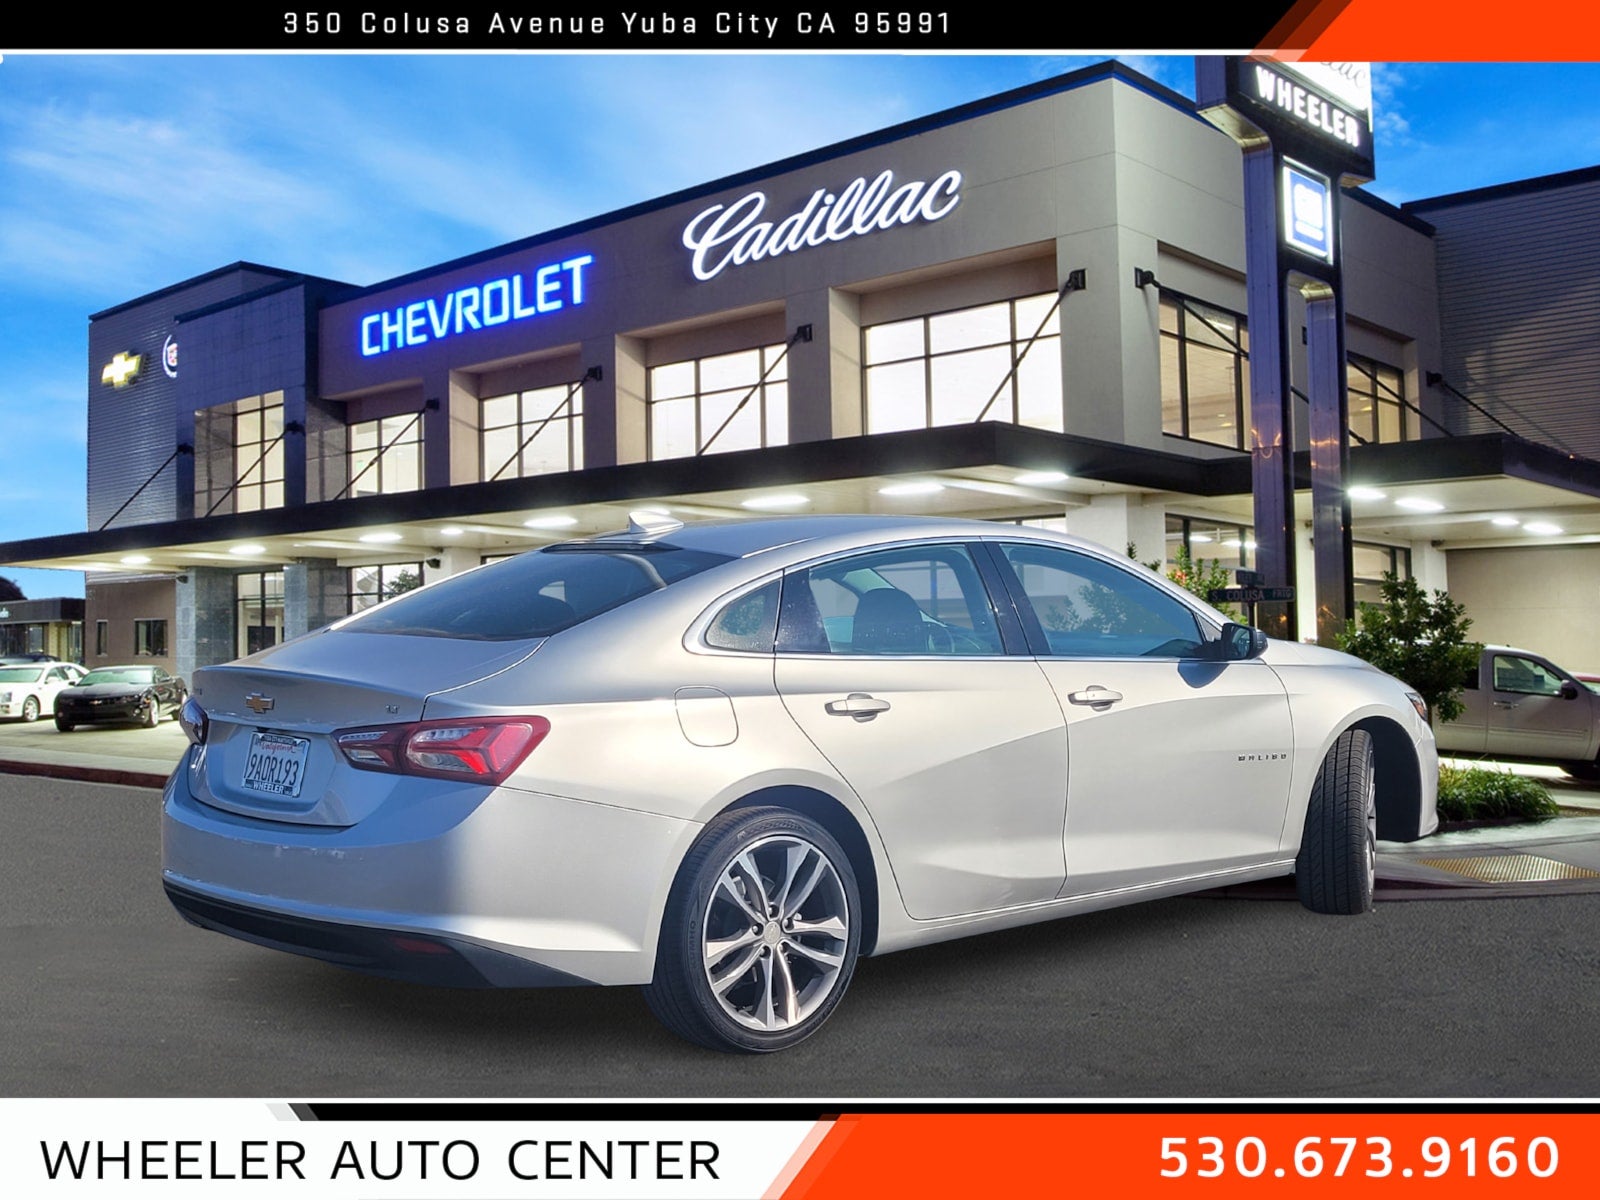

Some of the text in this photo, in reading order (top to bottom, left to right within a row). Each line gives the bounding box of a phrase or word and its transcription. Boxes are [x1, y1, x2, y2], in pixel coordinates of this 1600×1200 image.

[1255, 65, 1360, 148] WHEELER
[683, 168, 963, 281] Cadillac
[361, 254, 594, 357] CHEVROLET
[1226, 588, 1266, 600] COLUSA
[253, 780, 285, 795] WHEELER
